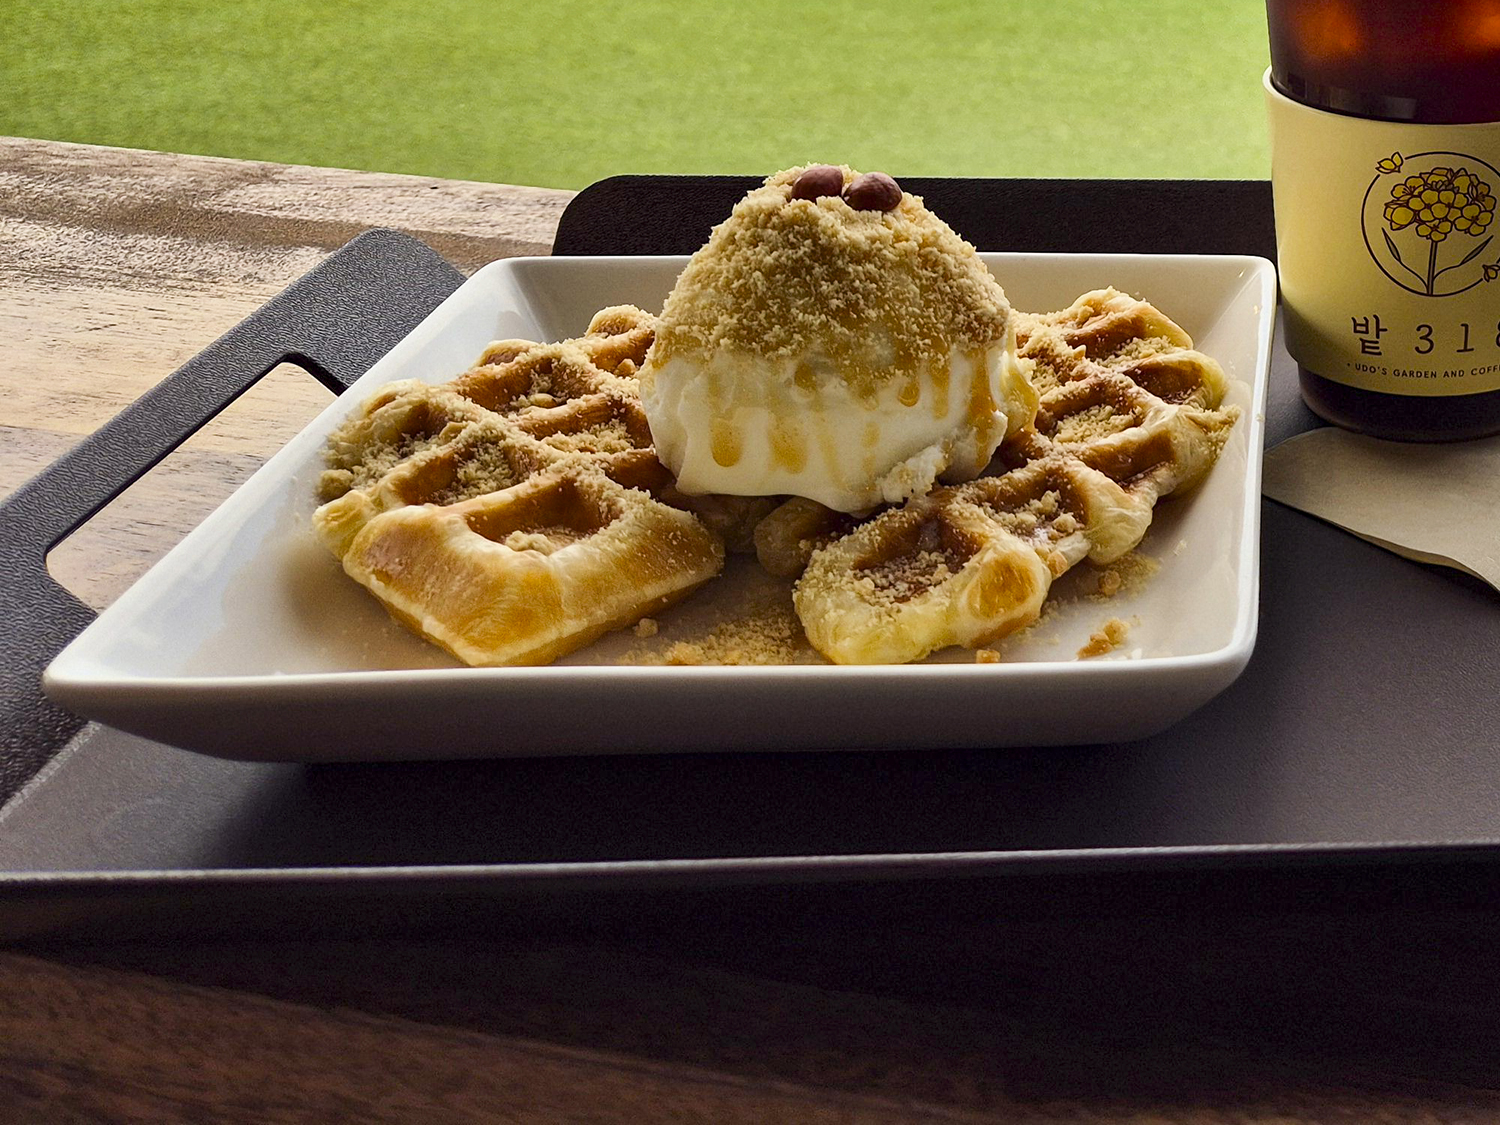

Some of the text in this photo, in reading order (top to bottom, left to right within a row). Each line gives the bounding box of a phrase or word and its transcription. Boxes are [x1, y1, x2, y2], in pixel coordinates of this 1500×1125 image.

[1351, 314, 1388, 356] 밭
[1355, 363, 1388, 376] UDO'S
[1393, 369, 1437, 379] GARDEN
[1443, 369, 1465, 378] AND
